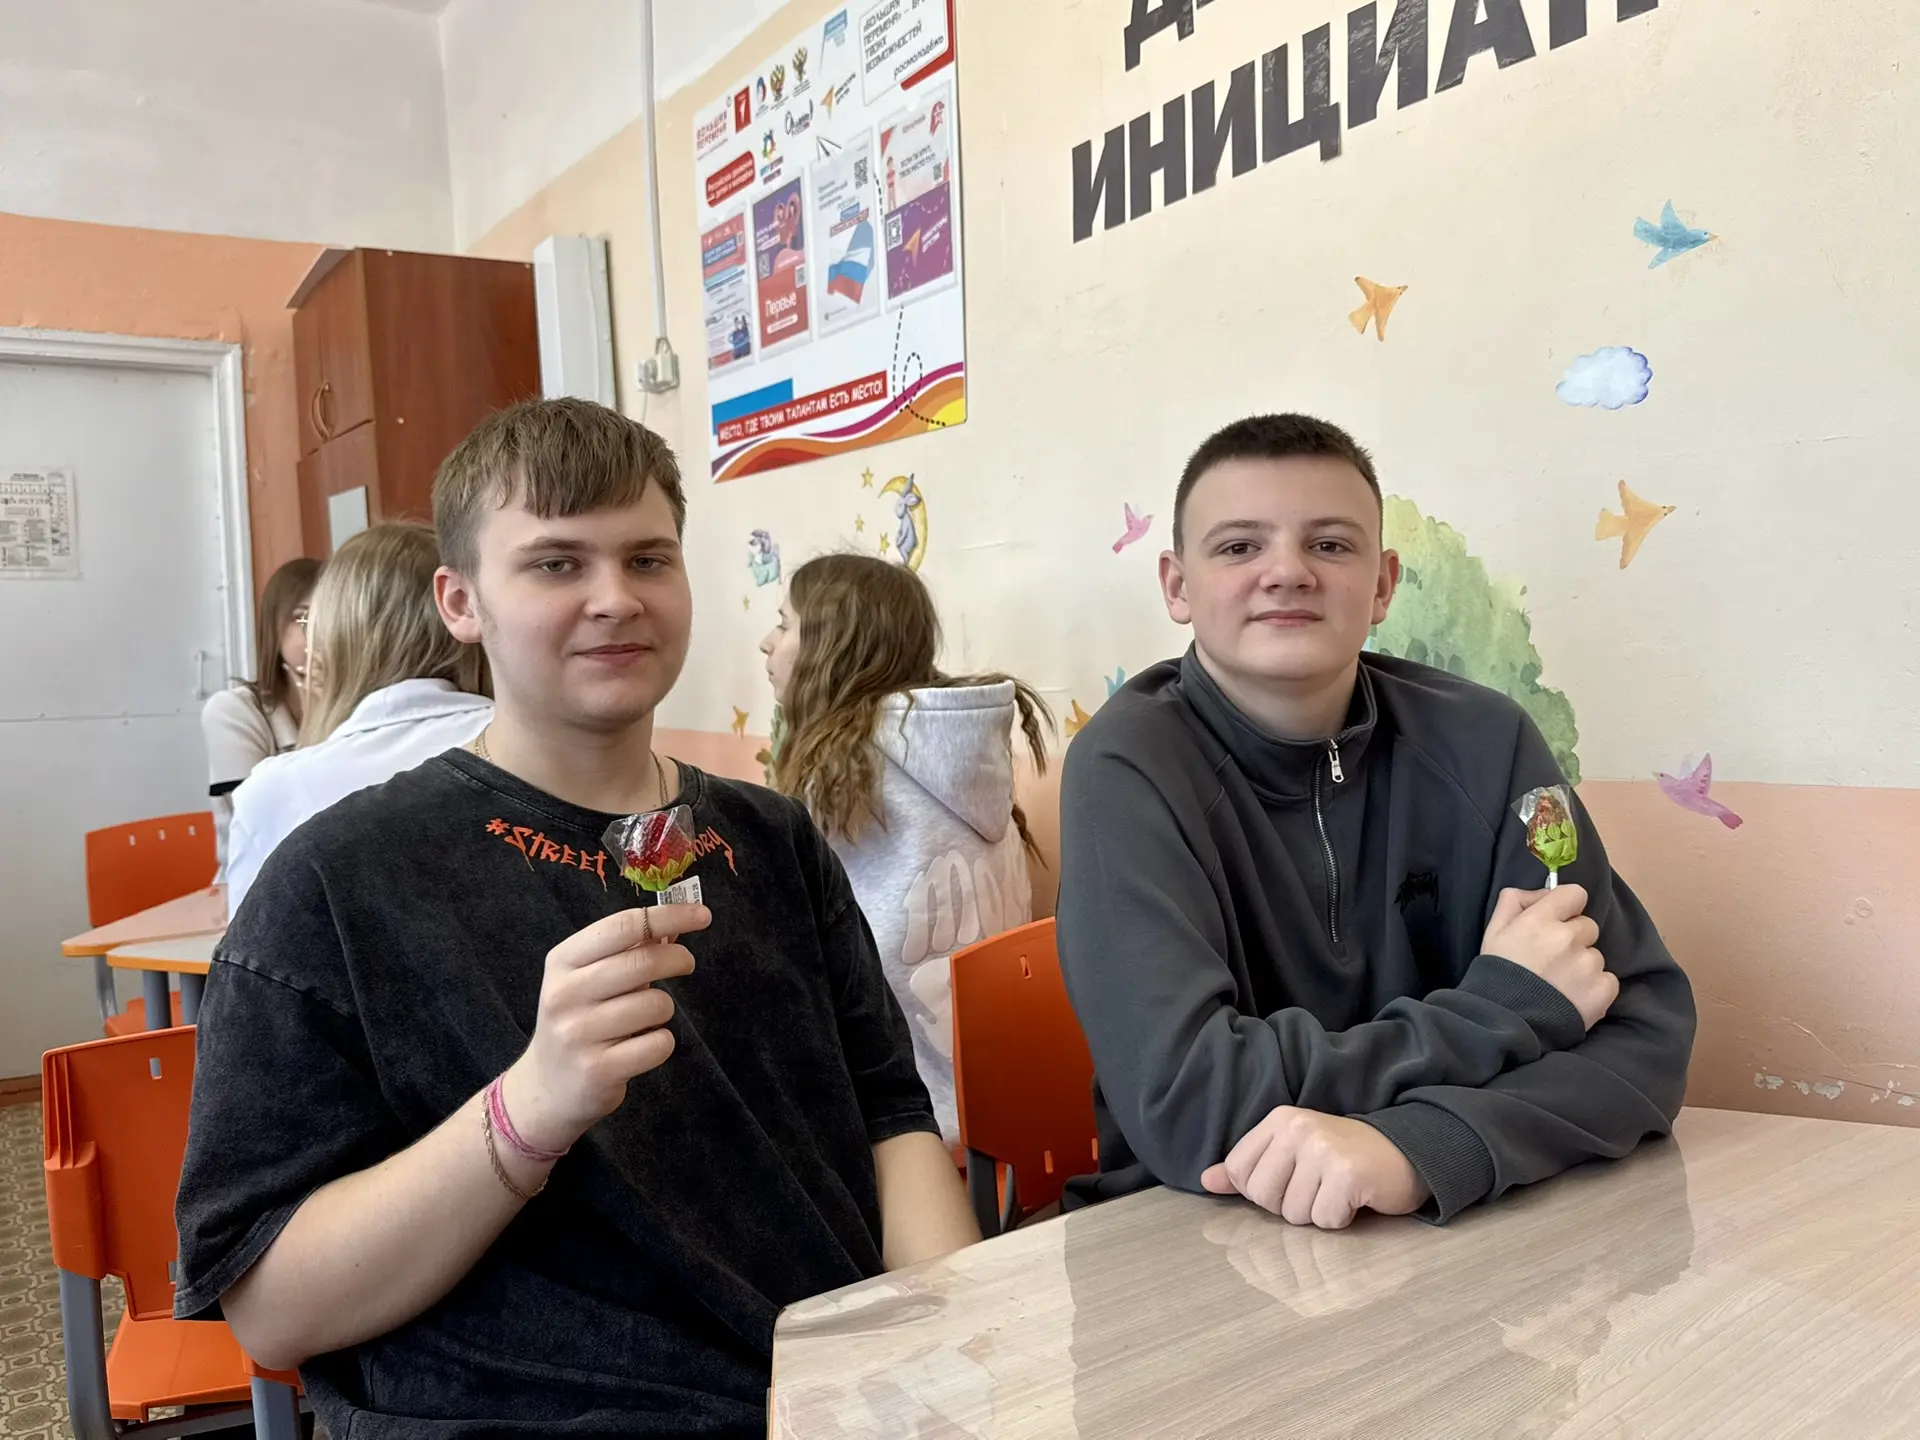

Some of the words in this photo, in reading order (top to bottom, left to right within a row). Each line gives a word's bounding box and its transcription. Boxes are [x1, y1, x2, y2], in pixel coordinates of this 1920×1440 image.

[1072, 0, 1658, 244] ИНИЦИА
[765, 292, 797, 319] Первые
[719, 425, 744, 440] МЕСТО,
[745, 418, 759, 434] ГДЕ
[760, 411, 785, 431] ТВОИМ
[785, 399, 828, 421] ТАЛАНТАМ
[829, 389, 849, 409] ЕСТЬ
[851, 378, 884, 402] МЕСТО!
